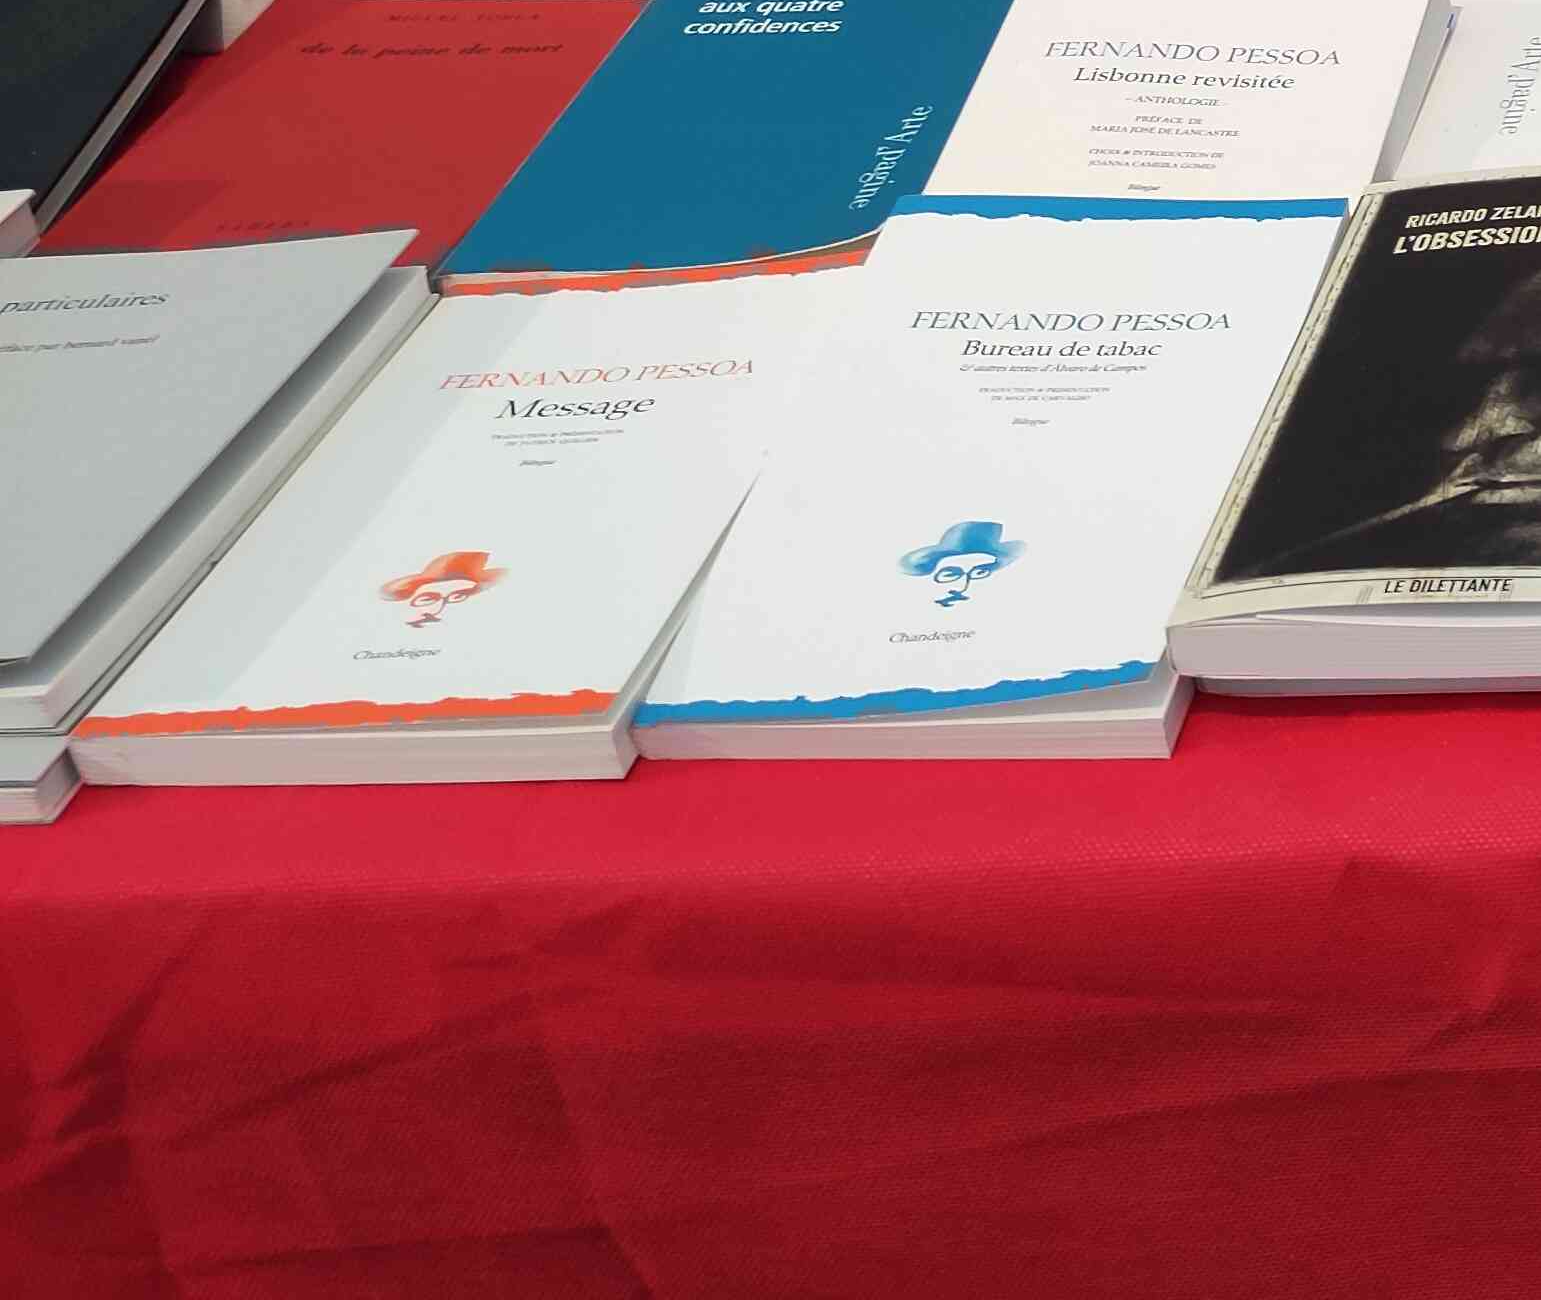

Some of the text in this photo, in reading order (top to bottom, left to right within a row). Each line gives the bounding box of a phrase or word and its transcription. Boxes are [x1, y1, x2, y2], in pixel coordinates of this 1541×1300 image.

[699, 0, 748, 14] aux
[684, 18, 842, 35] confidences
[1046, 41, 1341, 65] FERNANDO PESSOA
[1074, 67, 1295, 89] Lisbonne revisitée
[1406, 208, 1487, 229] RICARDO
[910, 311, 1231, 331] FERNANDO PESSOA
[962, 340, 1162, 357] Bureau de tabac
[438, 359, 754, 390] FERNANDO PESSOA
[496, 398, 656, 420] Message
[1385, 578, 1512, 593] LE DILETTANTE
